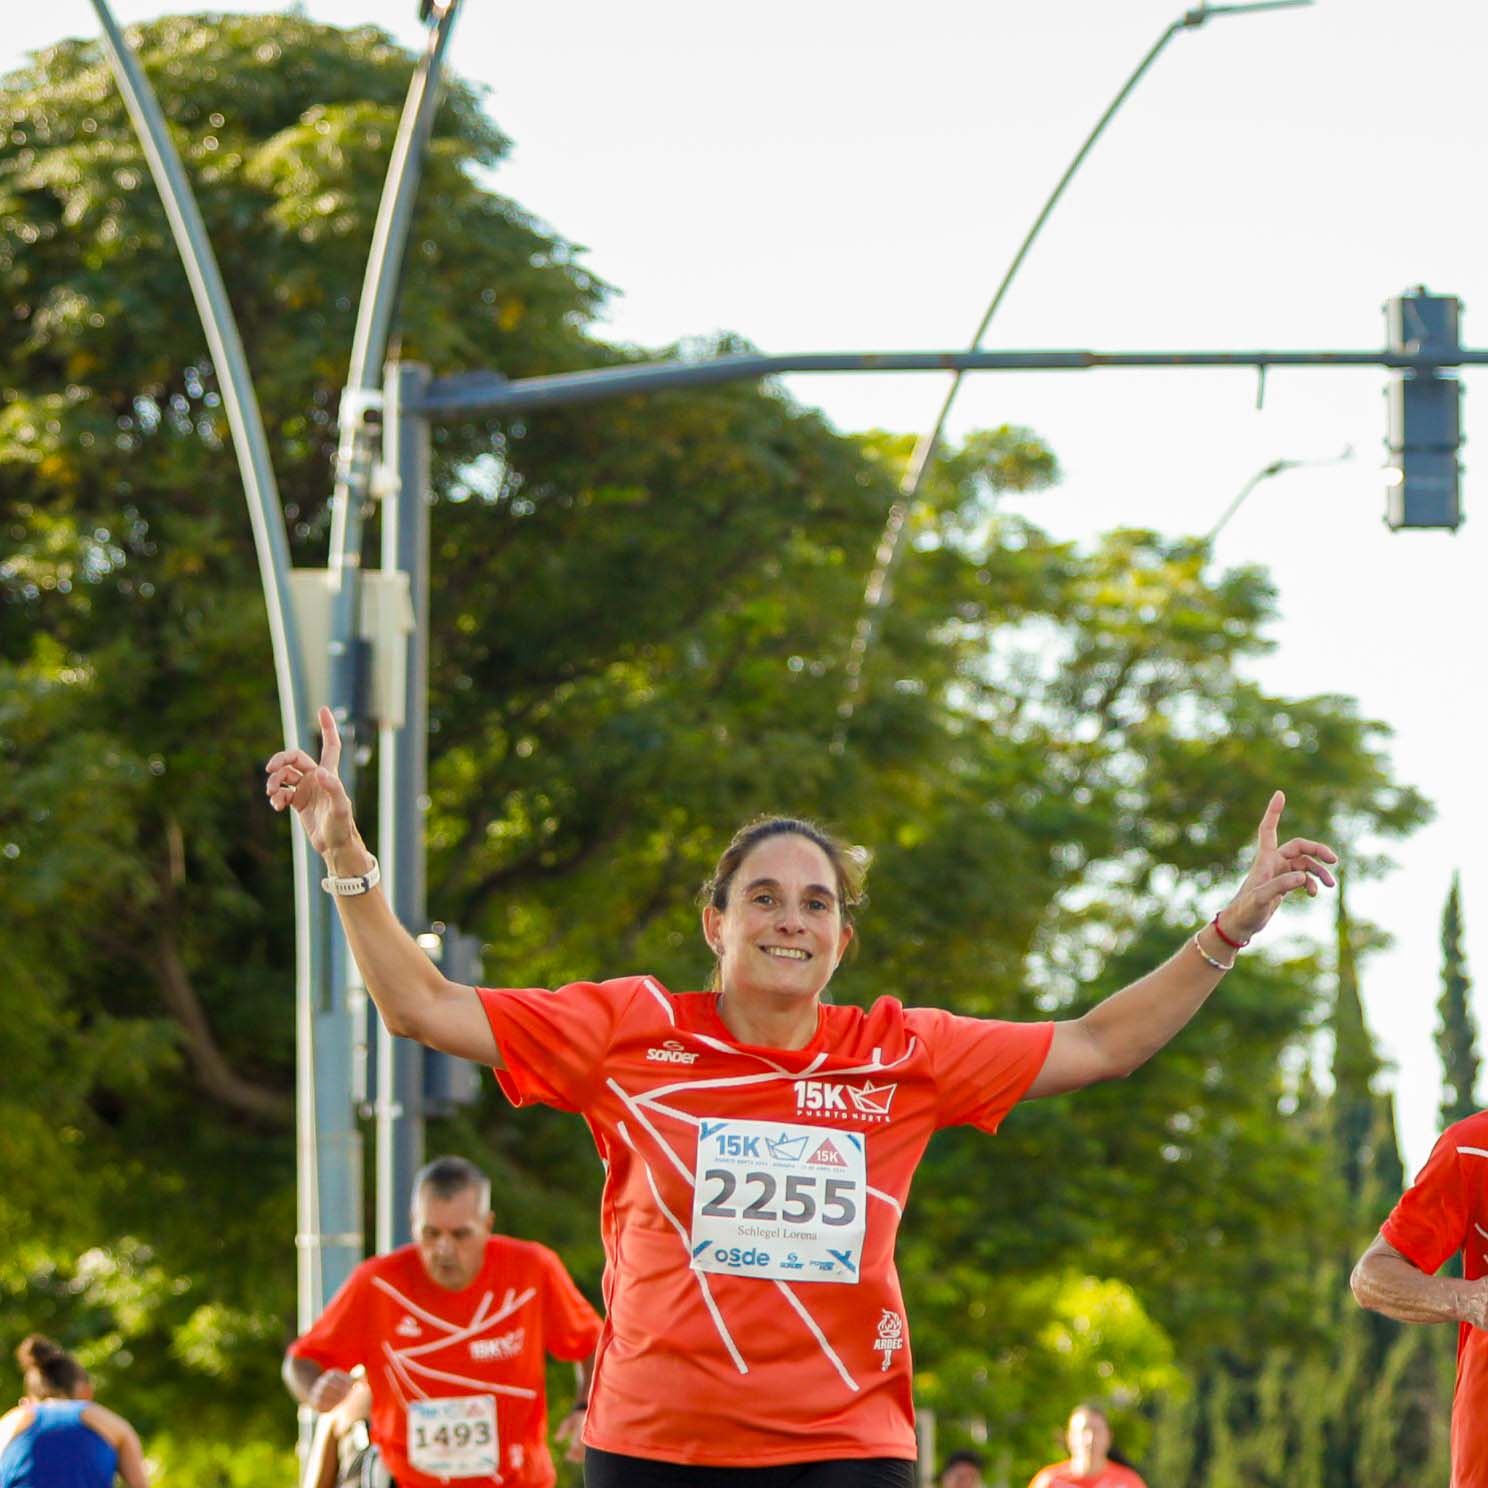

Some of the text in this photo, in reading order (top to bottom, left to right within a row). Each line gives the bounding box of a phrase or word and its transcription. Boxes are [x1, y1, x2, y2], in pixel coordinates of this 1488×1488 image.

[794, 1080, 848, 1110] 15K
[715, 1134, 761, 1158] 15K
[816, 1150, 839, 1163] 15K
[701, 1168, 857, 1226] 2255
[737, 1225, 818, 1241] Schlegel Lorena
[715, 1248, 770, 1267] osde
[415, 1420, 491, 1448] 1493
